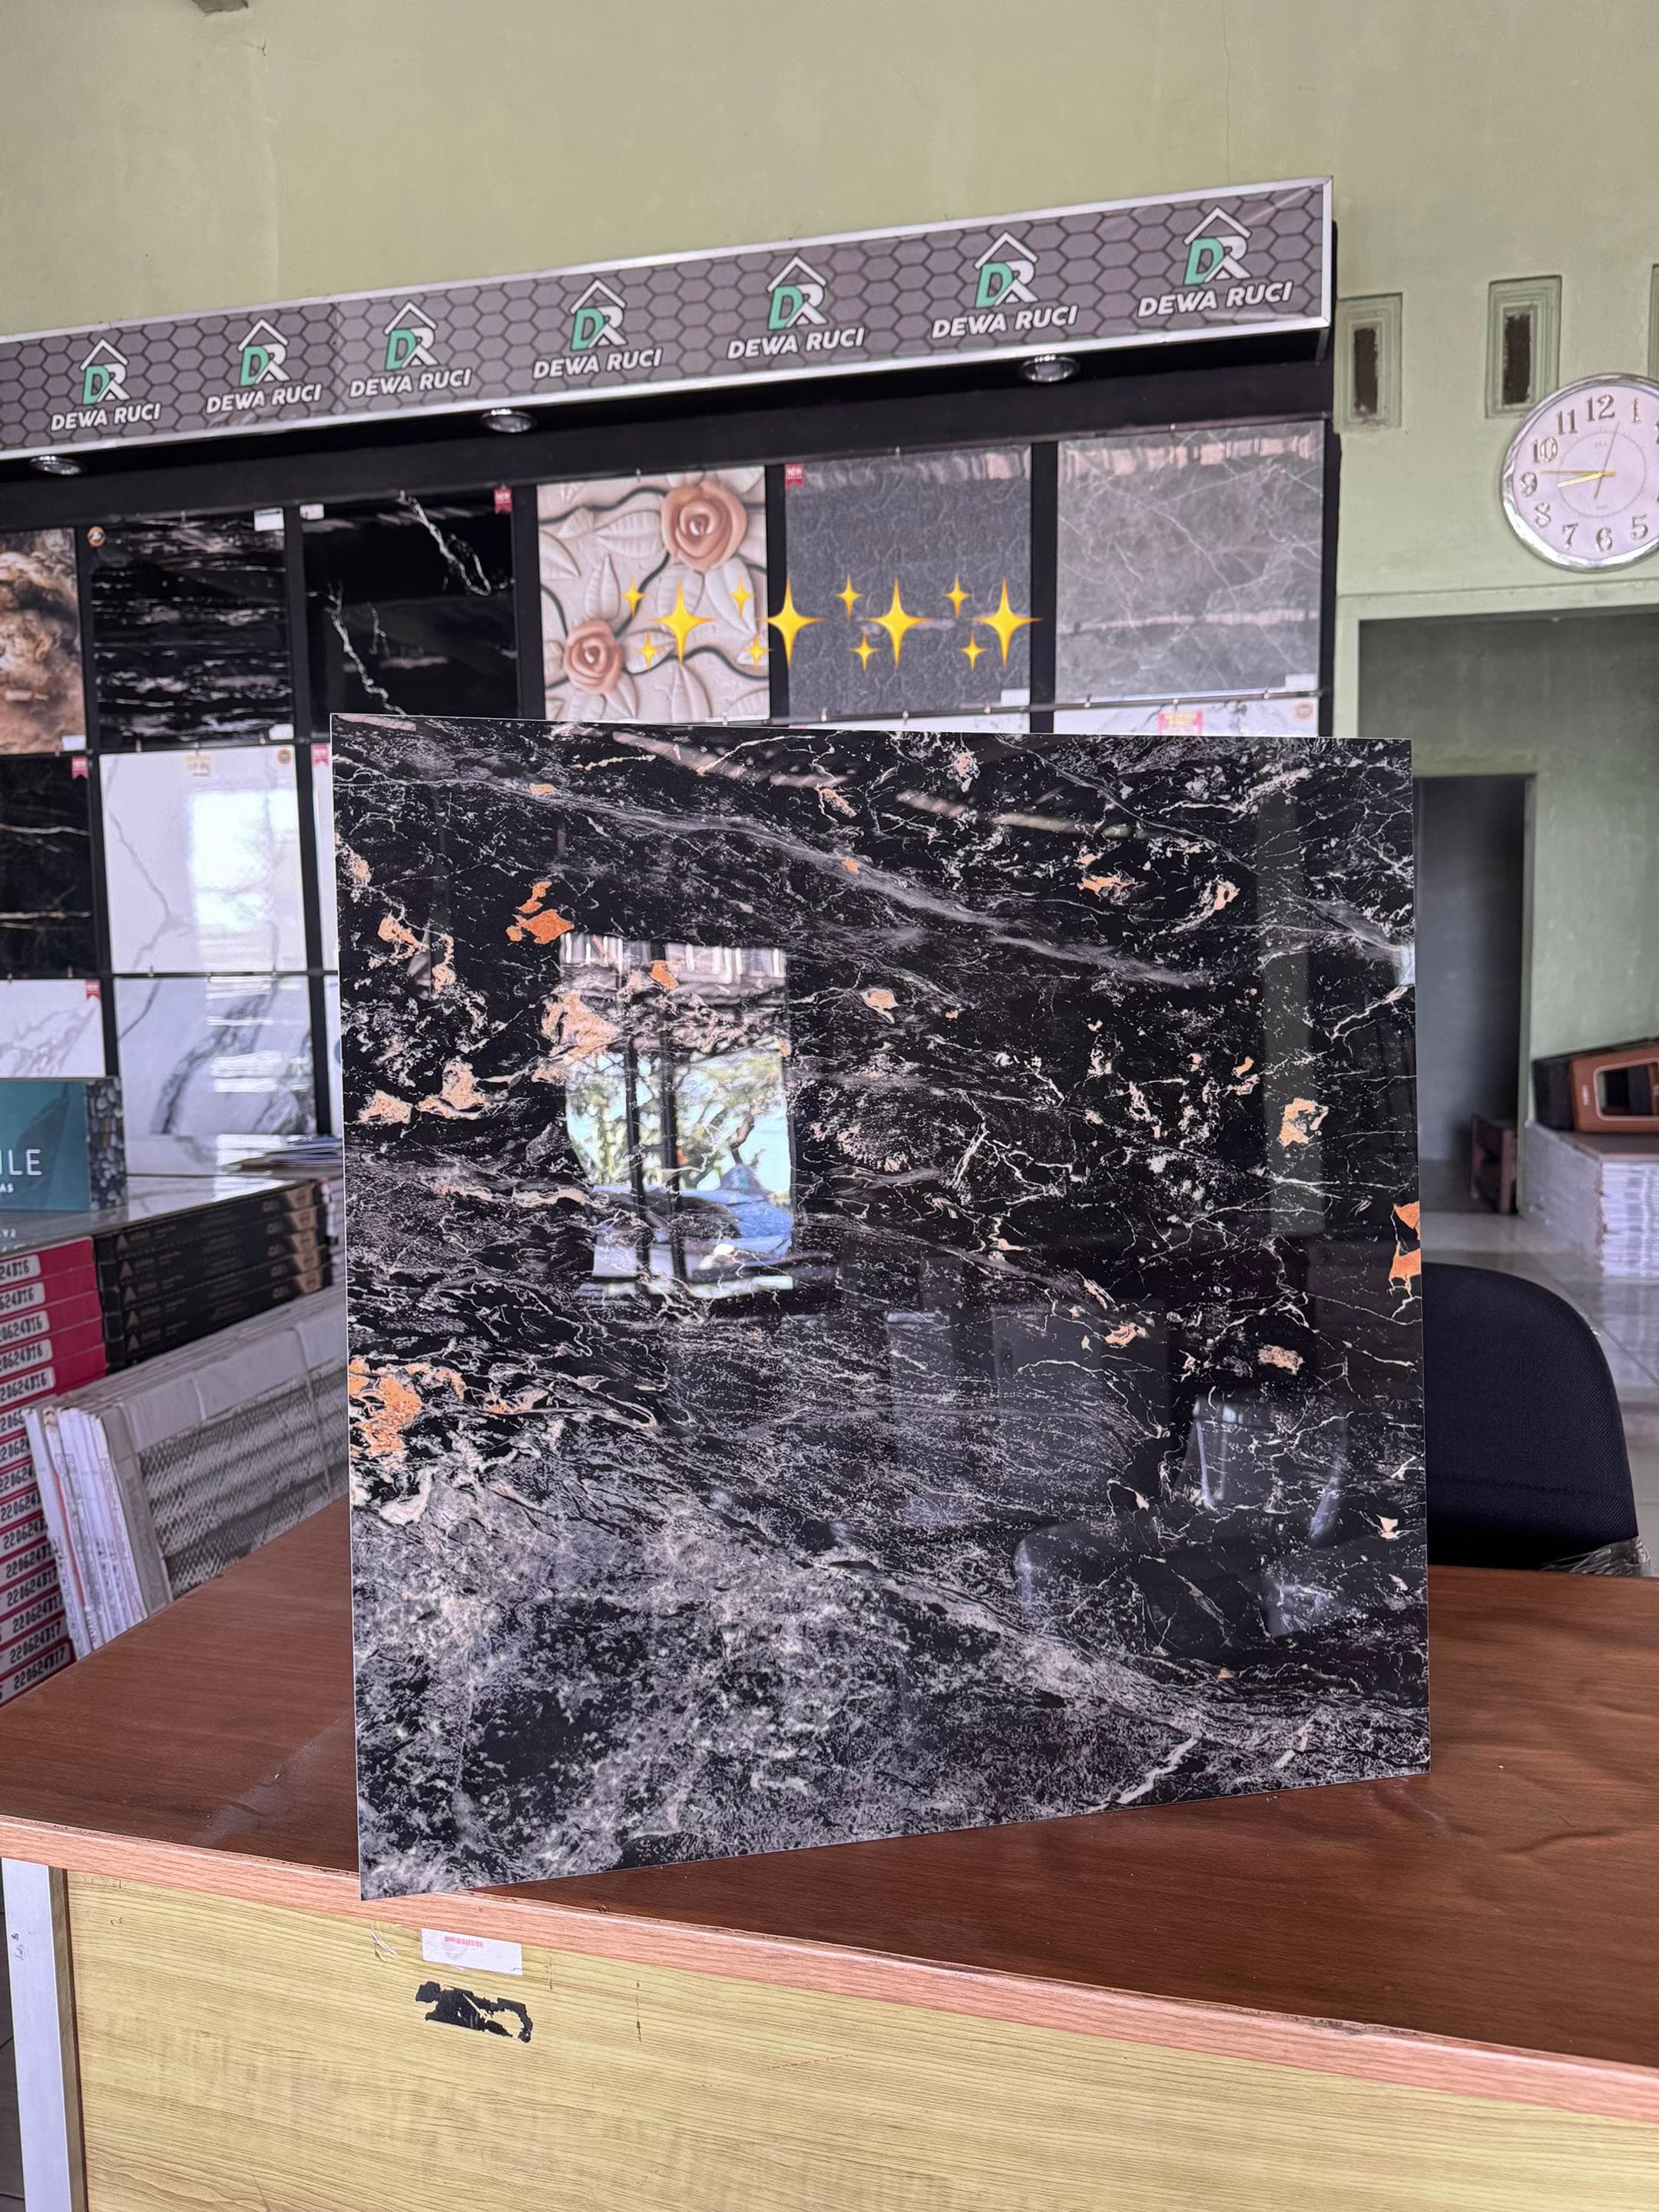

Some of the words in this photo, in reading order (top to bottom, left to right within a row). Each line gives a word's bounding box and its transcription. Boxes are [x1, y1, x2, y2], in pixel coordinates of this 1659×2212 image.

[1137, 289, 1217, 318] DEWA
[1226, 281, 1293, 308] RUCI
[932, 311, 1007, 339] DEWA
[1015, 305, 1079, 330] RUCI
[727, 333, 798, 359] DEWA
[806, 327, 866, 352] RUCI
[533, 355, 601, 379] DEWA
[607, 347, 663, 370] RUCI
[349, 374, 412, 398] DEWA
[419, 369, 472, 390] RUCI
[206, 390, 266, 413] DEWA
[272, 384, 323, 405] RUCI
[1586, 394, 1615, 422] 12
[1631, 398, 1641, 423] 1
[51, 409, 108, 431] DEWA
[114, 403, 161, 423] RUCI
[1557, 409, 1578, 435] 11
[1532, 437, 1558, 463] 10
[1520, 471, 1538, 498] 9
[1535, 502, 1551, 528] 8
[1631, 514, 1649, 539] 5
[1563, 522, 1578, 549] 7
[1596, 527, 1613, 552] 6
